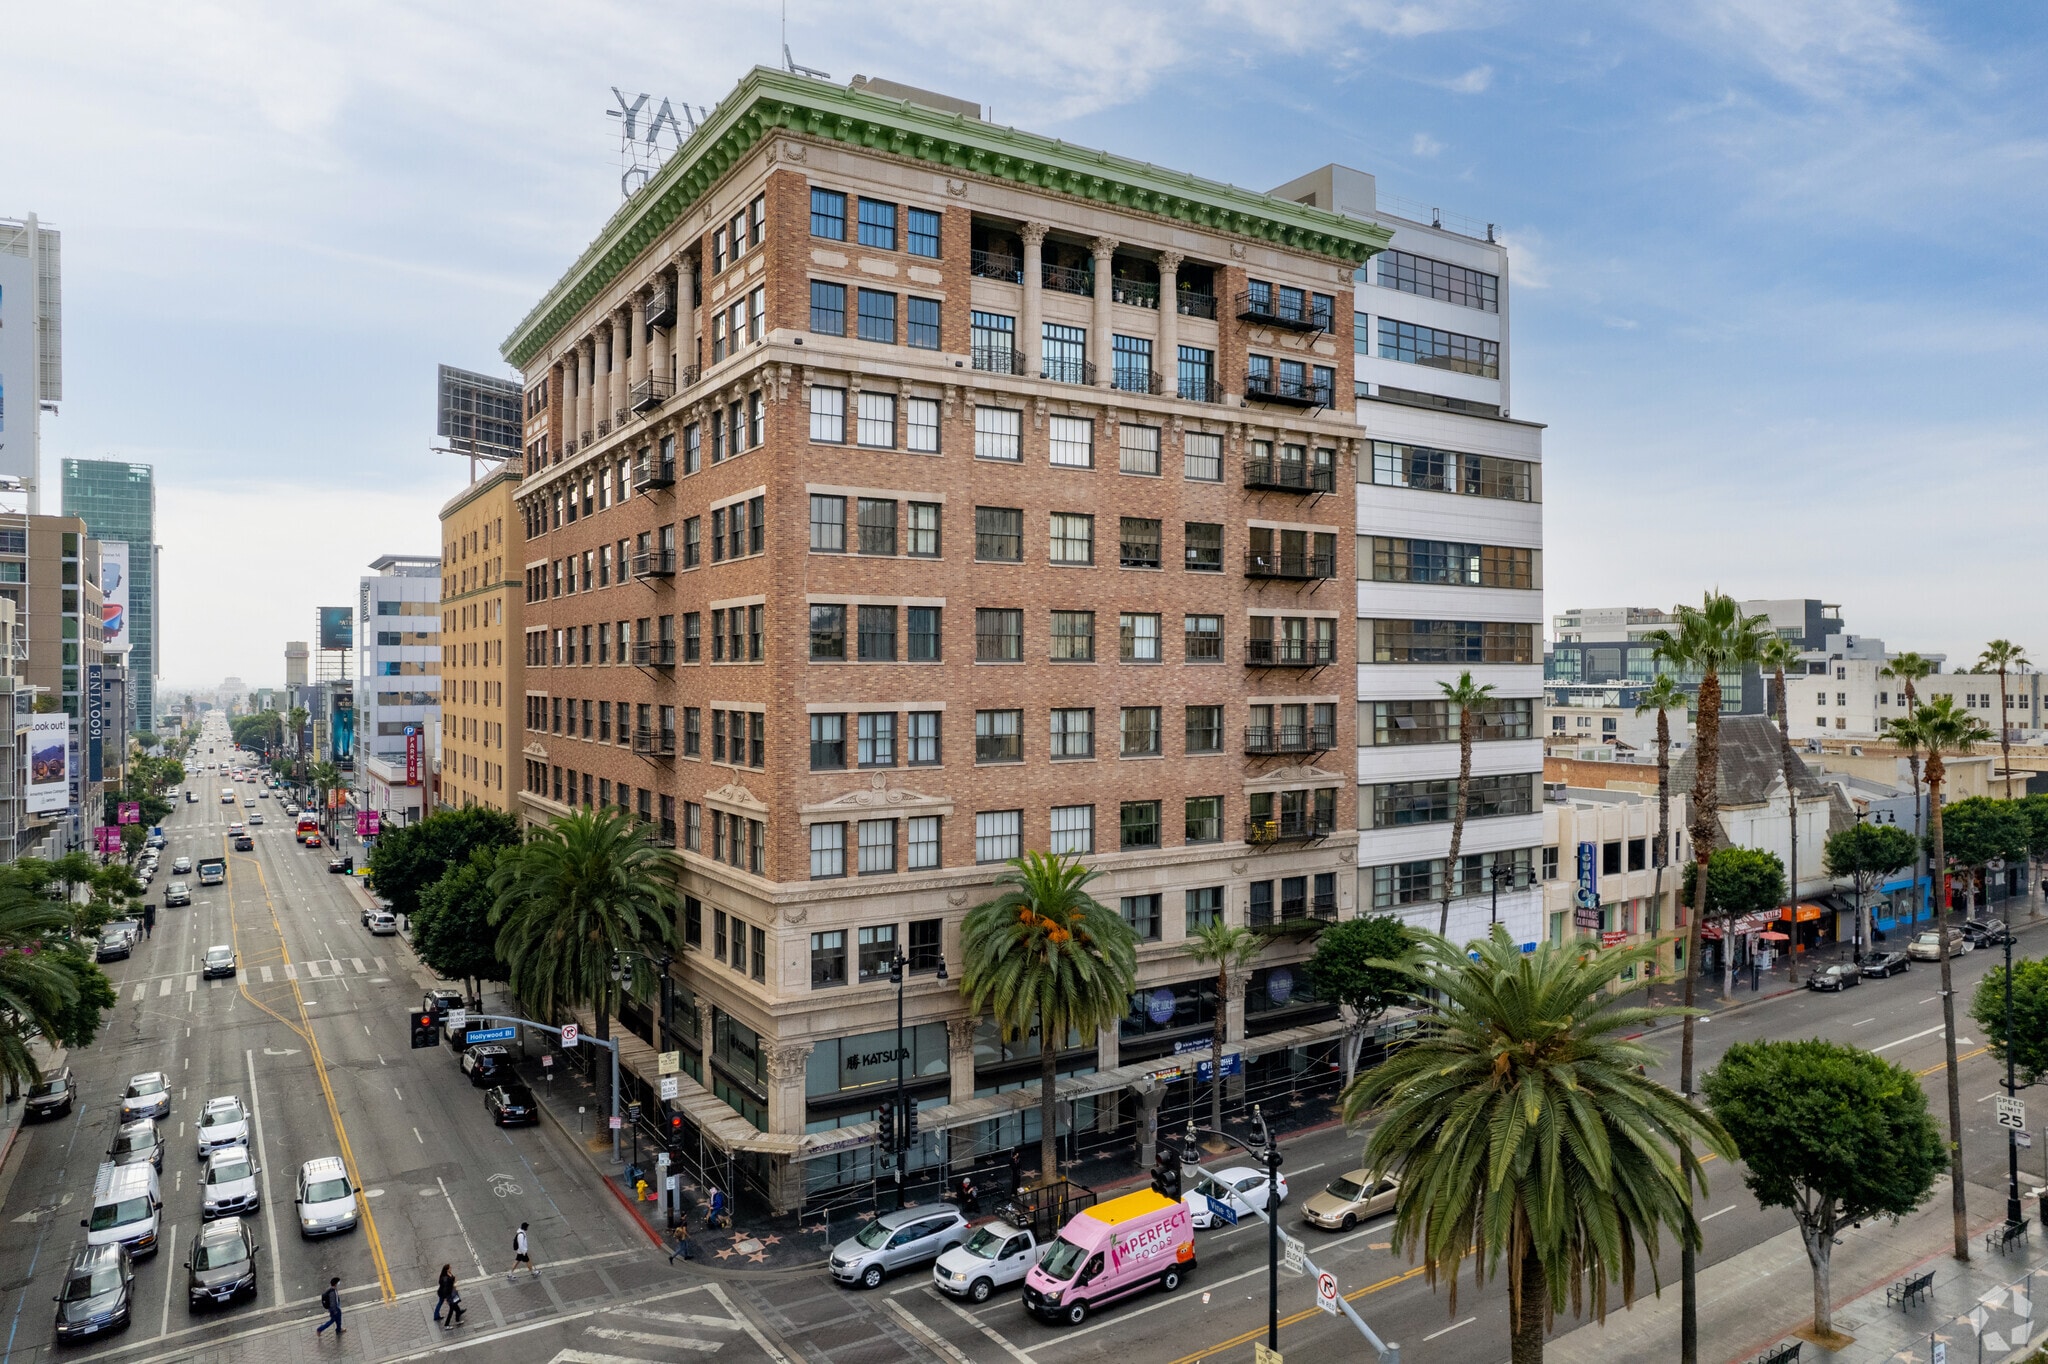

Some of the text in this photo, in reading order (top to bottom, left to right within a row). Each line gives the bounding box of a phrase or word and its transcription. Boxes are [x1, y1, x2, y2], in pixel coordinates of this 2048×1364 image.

[90, 671, 101, 708] VINE
[50, 721, 66, 730] out!
[1577, 909, 1599, 918] VINTAGE
[1763, 908, 1782, 919] NAILS
[1576, 917, 1600, 928] CLOTHING
[470, 1031, 503, 1042] Hollywood
[1997, 1097, 2024, 1108] SPEED
[2000, 1105, 2021, 1114] LIMIT
[1999, 1112, 2023, 1128] 25
[1210, 1200, 1234, 1220] Vine St
[1135, 1236, 1173, 1263] FOODS
[1295, 1243, 1303, 1253] NOT
[1286, 1250, 1302, 1263] BLOCK
[1326, 1299, 1335, 1311] RED
